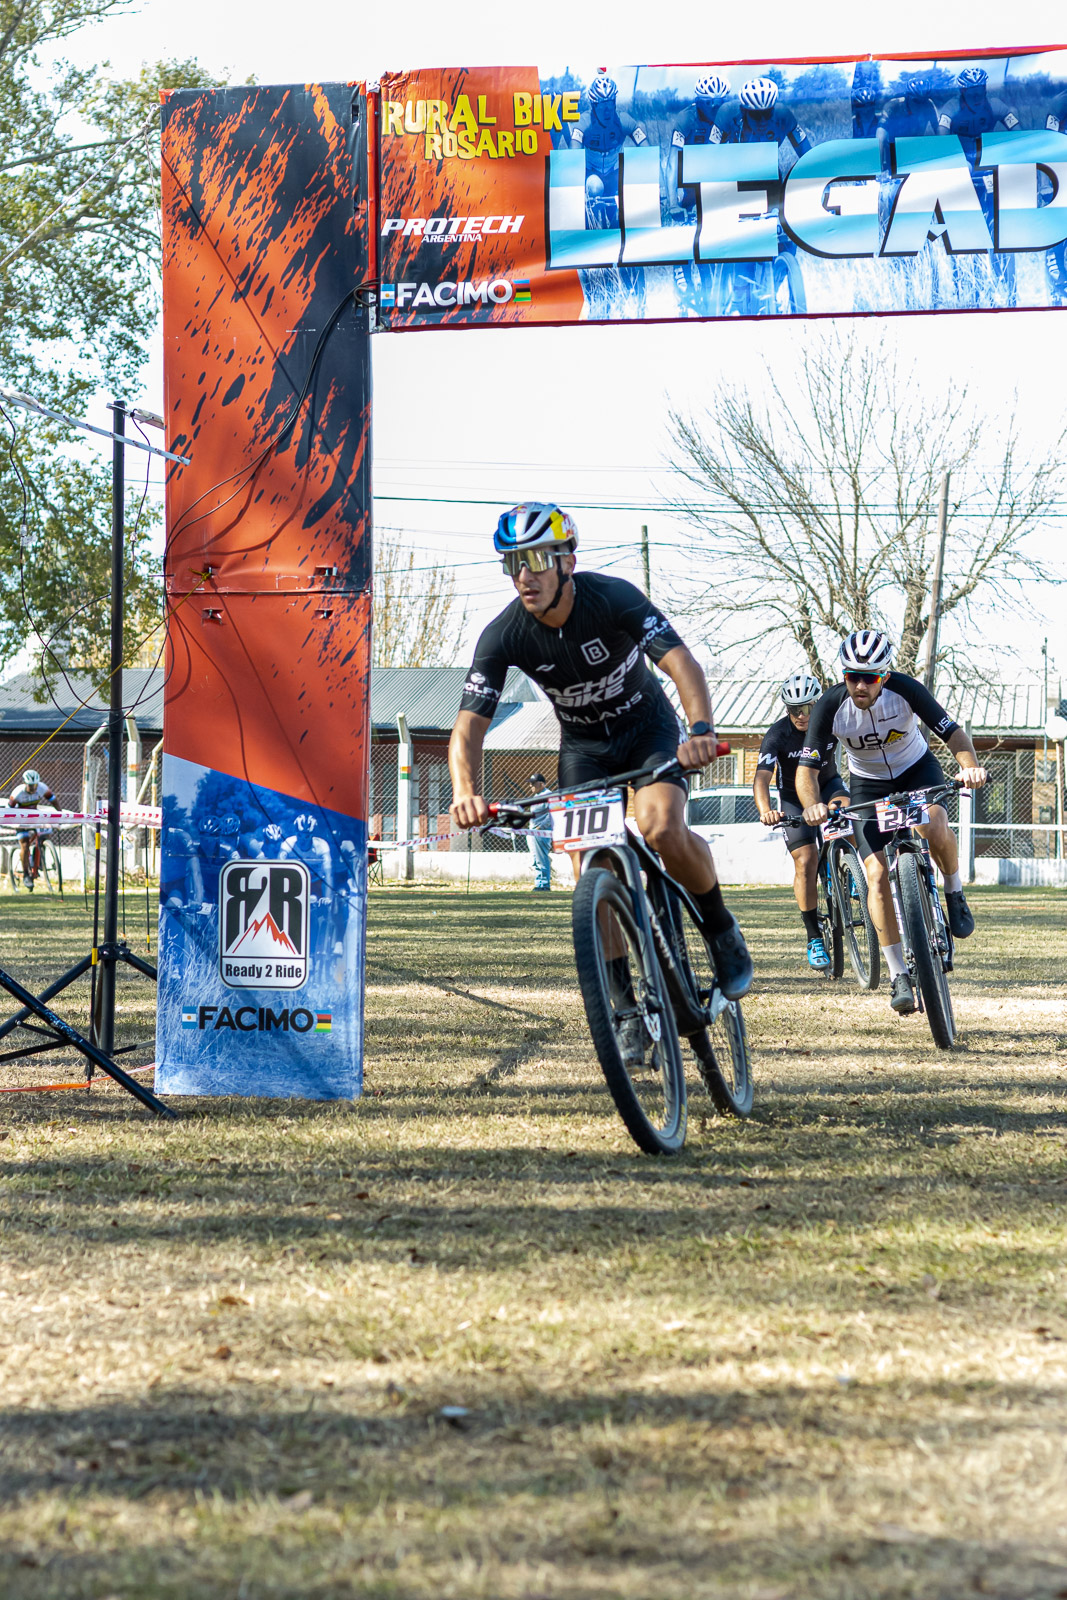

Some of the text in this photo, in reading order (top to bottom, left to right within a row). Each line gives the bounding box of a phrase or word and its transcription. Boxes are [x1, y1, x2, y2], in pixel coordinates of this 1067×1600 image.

[382, 91, 581, 136] RURAL BIKE
[425, 129, 538, 160] ROSARIO
[381, 215, 525, 236] PROTECH
[421, 234, 482, 243] ARGENTINA
[396, 279, 513, 307] FACIMO
[639, 620, 669, 649] WOLF
[540, 644, 639, 697] ACHOS
[463, 682, 501, 698] OLFY
[555, 677, 625, 707] BIKE
[563, 805, 610, 838] 110
[225, 963, 302, 978] Ready 2 Ride
[198, 1006, 314, 1032] FACIMO
